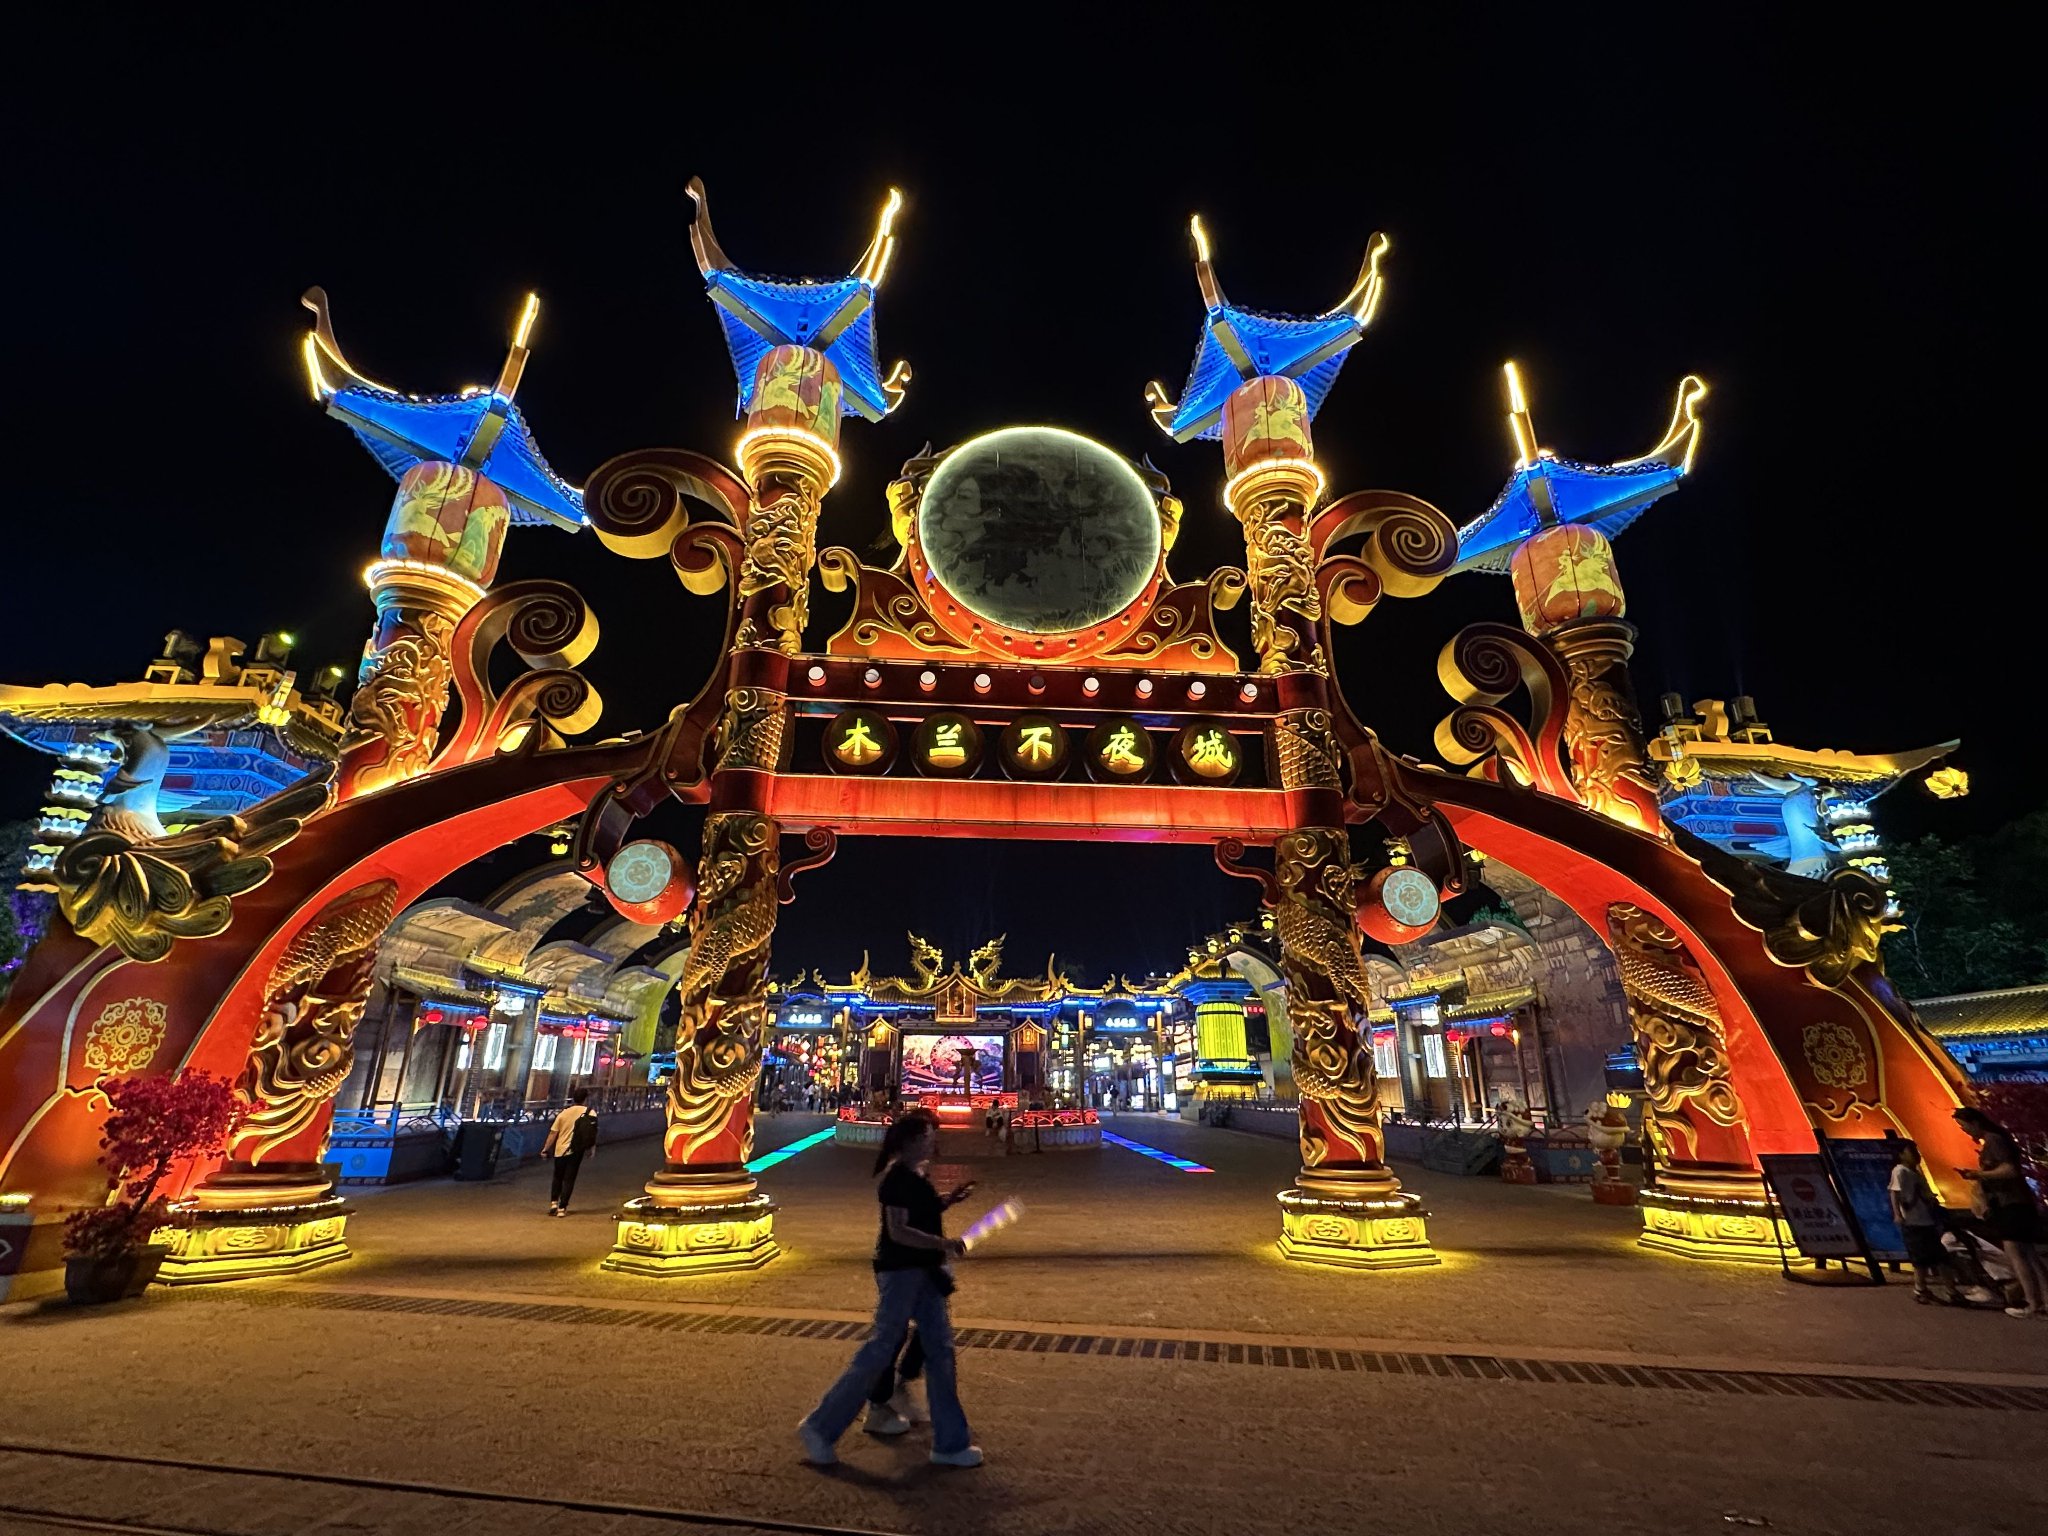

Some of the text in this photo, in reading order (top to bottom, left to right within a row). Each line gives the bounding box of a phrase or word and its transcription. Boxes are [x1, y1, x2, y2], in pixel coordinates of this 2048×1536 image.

[838, 718, 1232, 768] 木兰不夜城
